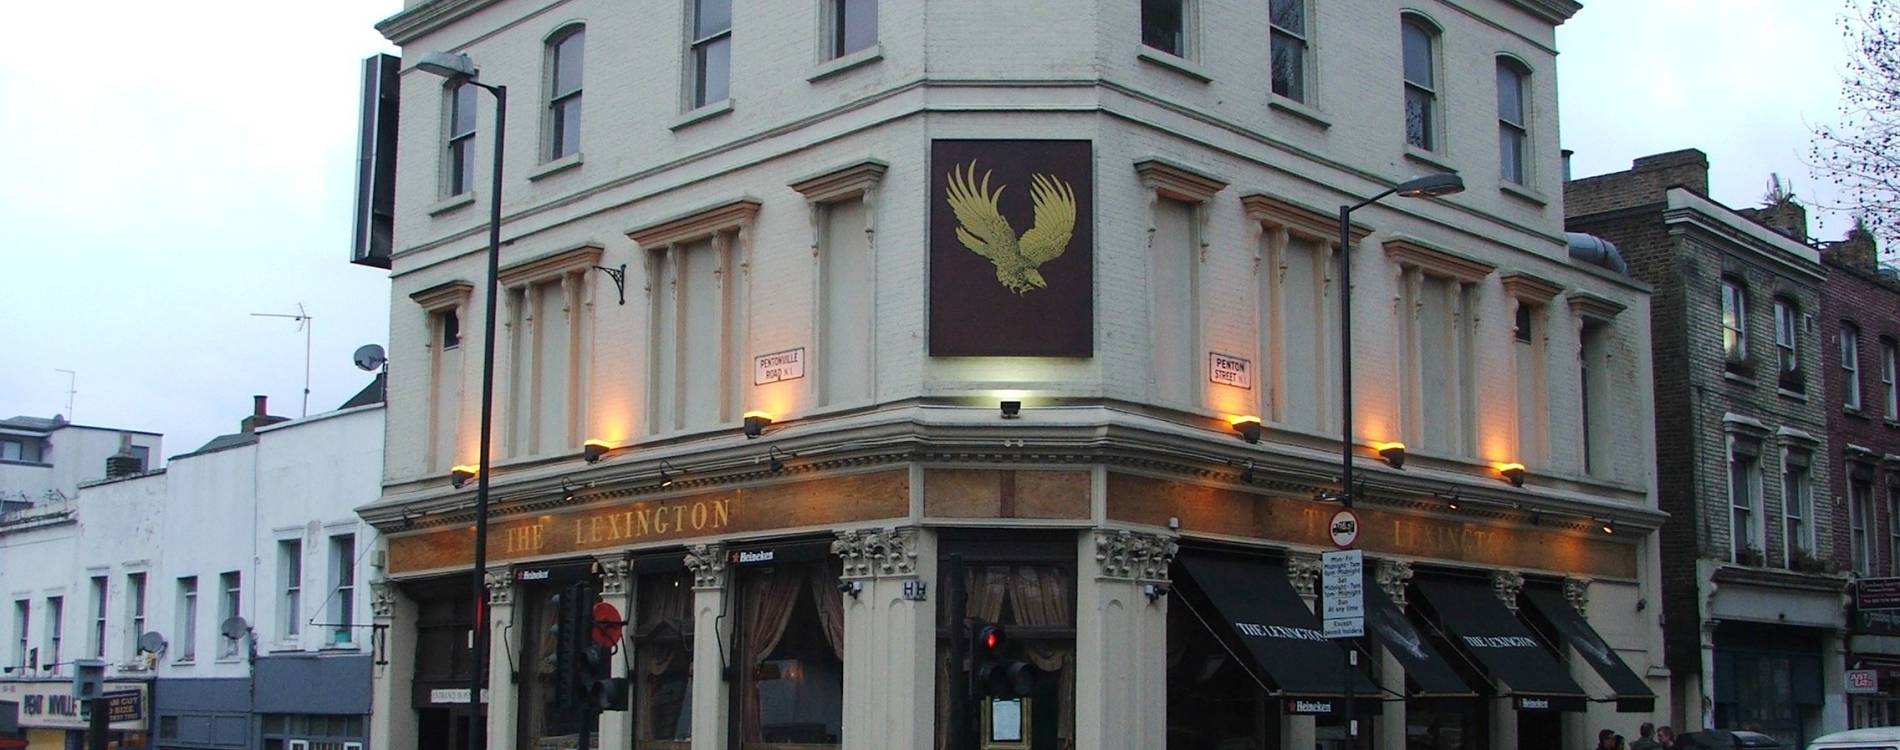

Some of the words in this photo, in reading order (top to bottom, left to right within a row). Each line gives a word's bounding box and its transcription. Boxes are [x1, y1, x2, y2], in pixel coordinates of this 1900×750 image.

[760, 352, 797, 367] PENTONVILLE
[1216, 358, 1245, 371] PENTON
[766, 368, 782, 378] ROAD
[1215, 369, 1236, 382] STREET
[505, 524, 544, 553] THE
[575, 499, 731, 545] LEXINGTON
[741, 551, 774, 562] Heineken
[1236, 623, 1267, 636] THE
[1463, 636, 1488, 647] THE
[1483, 636, 1538, 648] LEXINGTON
[1296, 701, 1332, 713] Heineken
